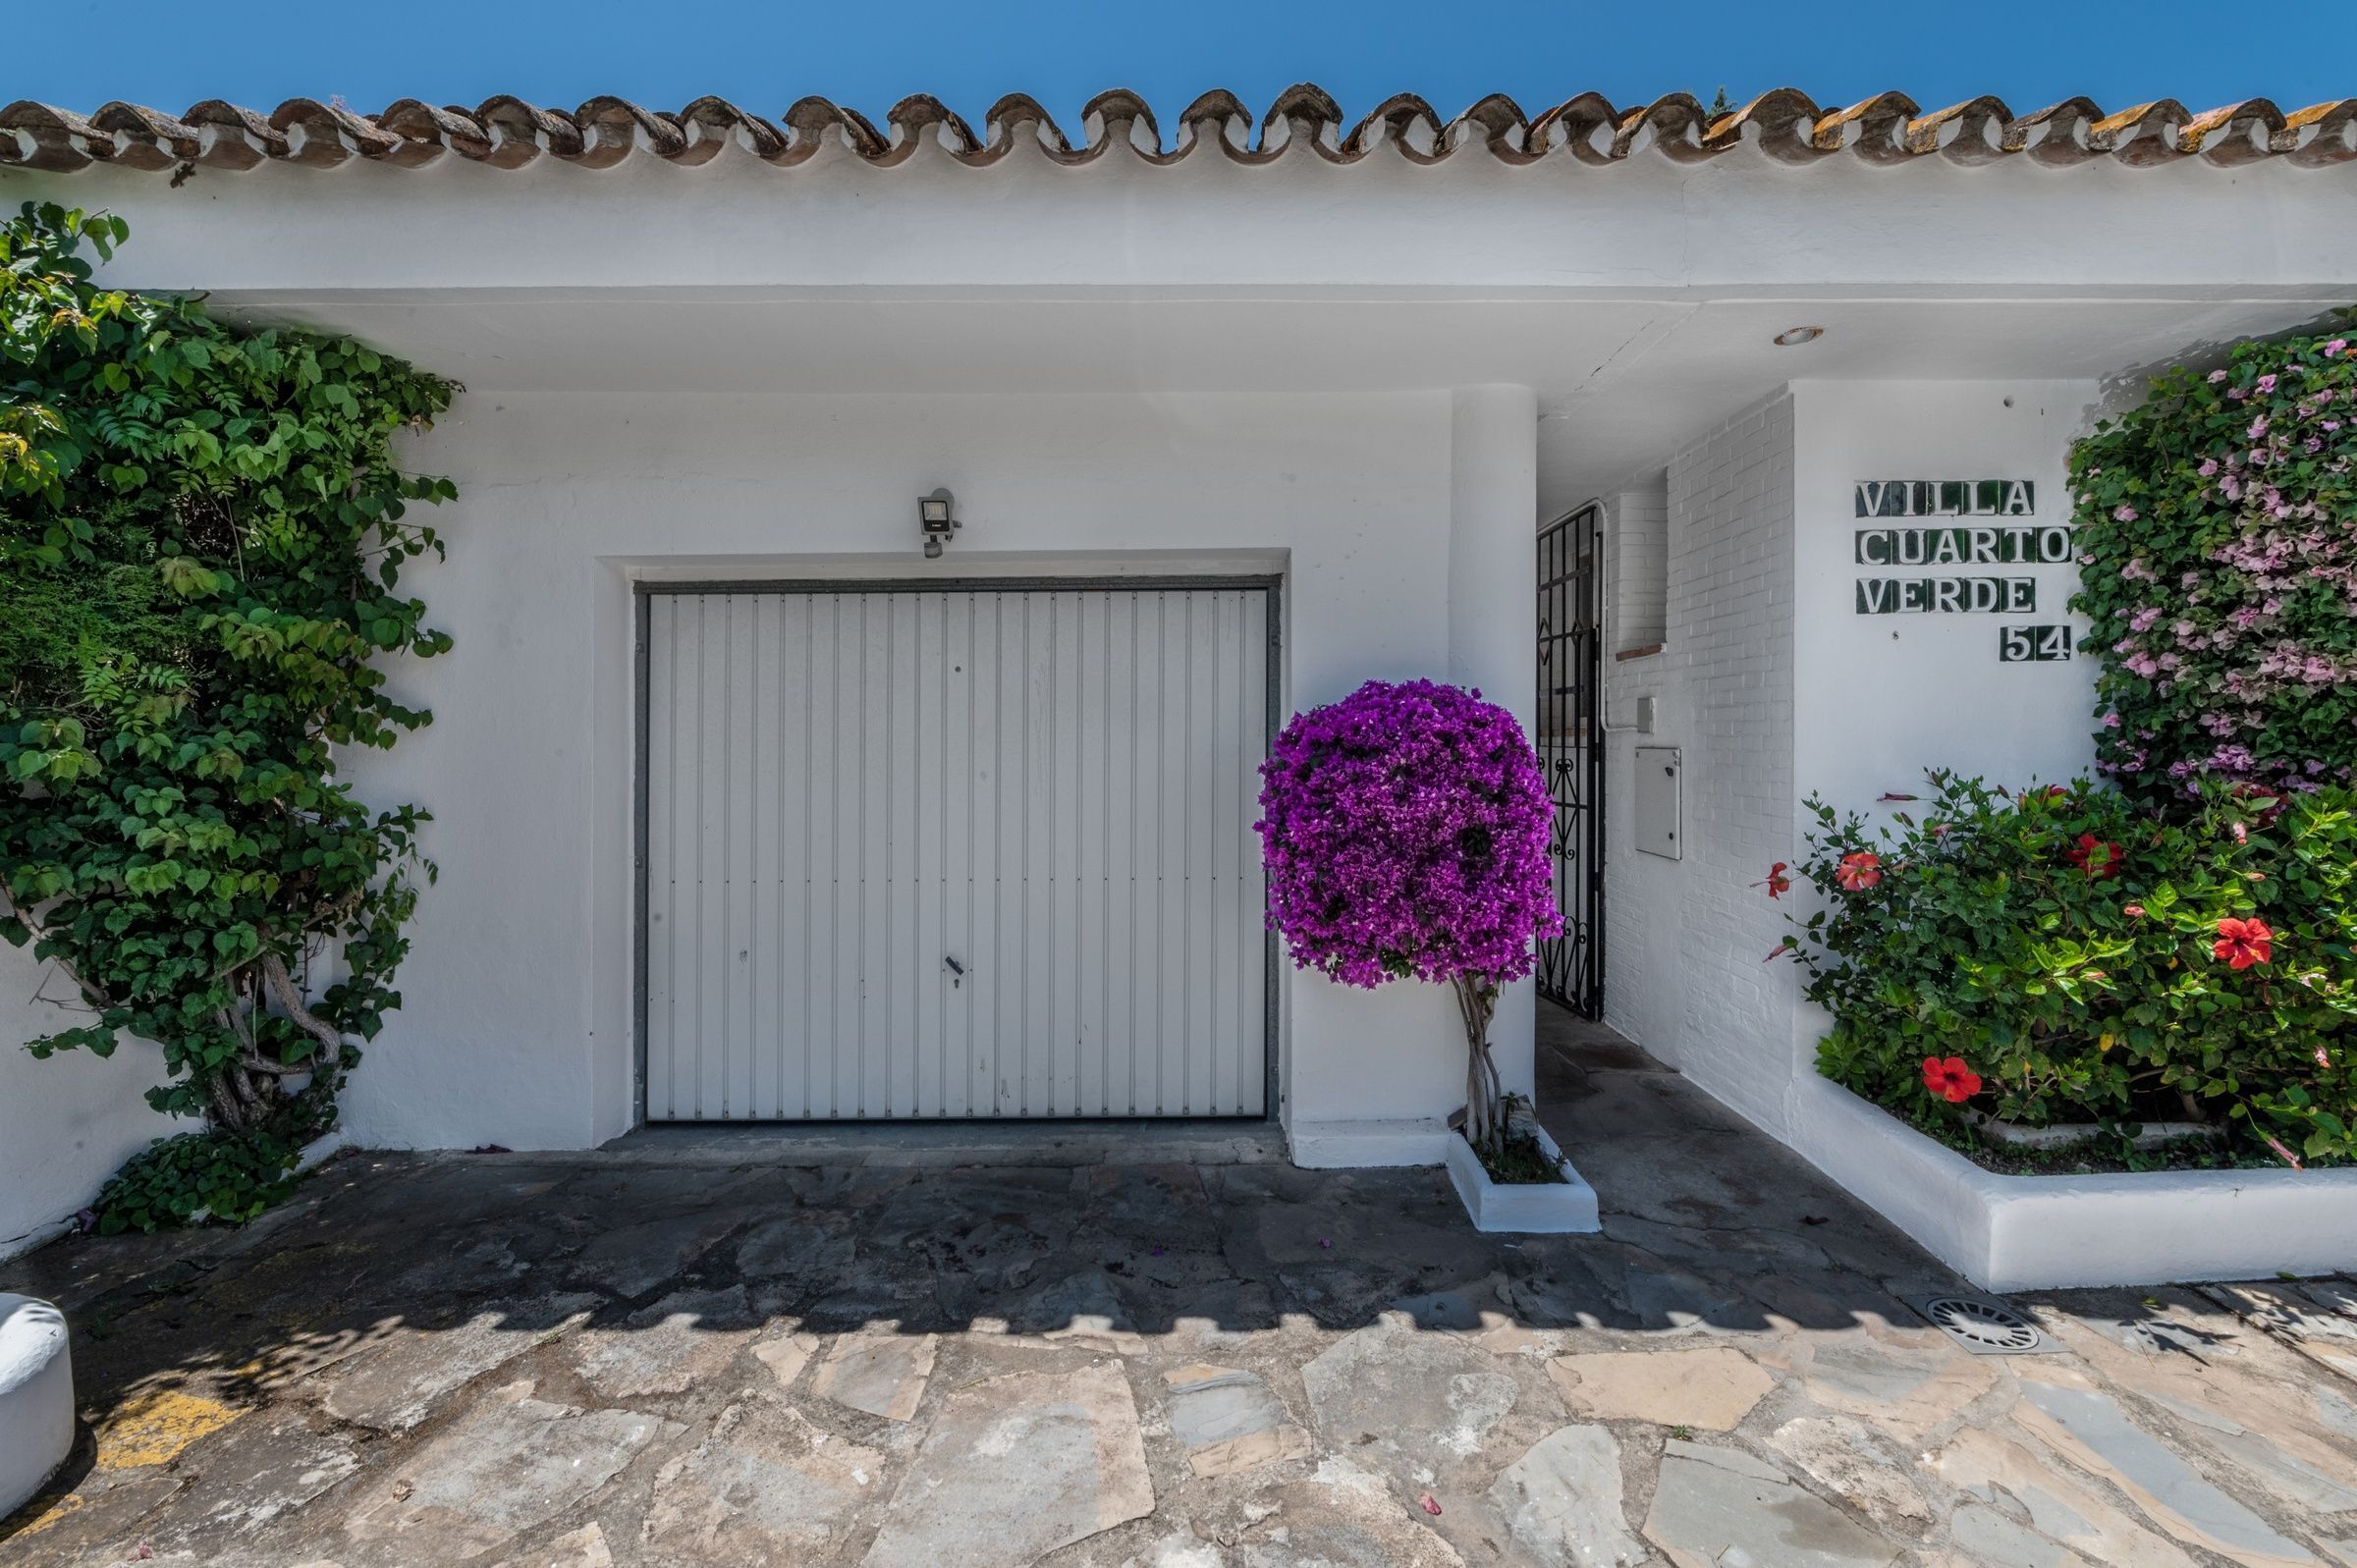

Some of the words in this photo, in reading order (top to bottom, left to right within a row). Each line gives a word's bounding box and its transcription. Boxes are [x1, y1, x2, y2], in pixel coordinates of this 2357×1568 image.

[1857, 481, 2033, 516] VILLA
[1860, 527, 2070, 565] CUARTO
[1860, 577, 2033, 613] VERDE
[2005, 626, 2070, 661] 54
